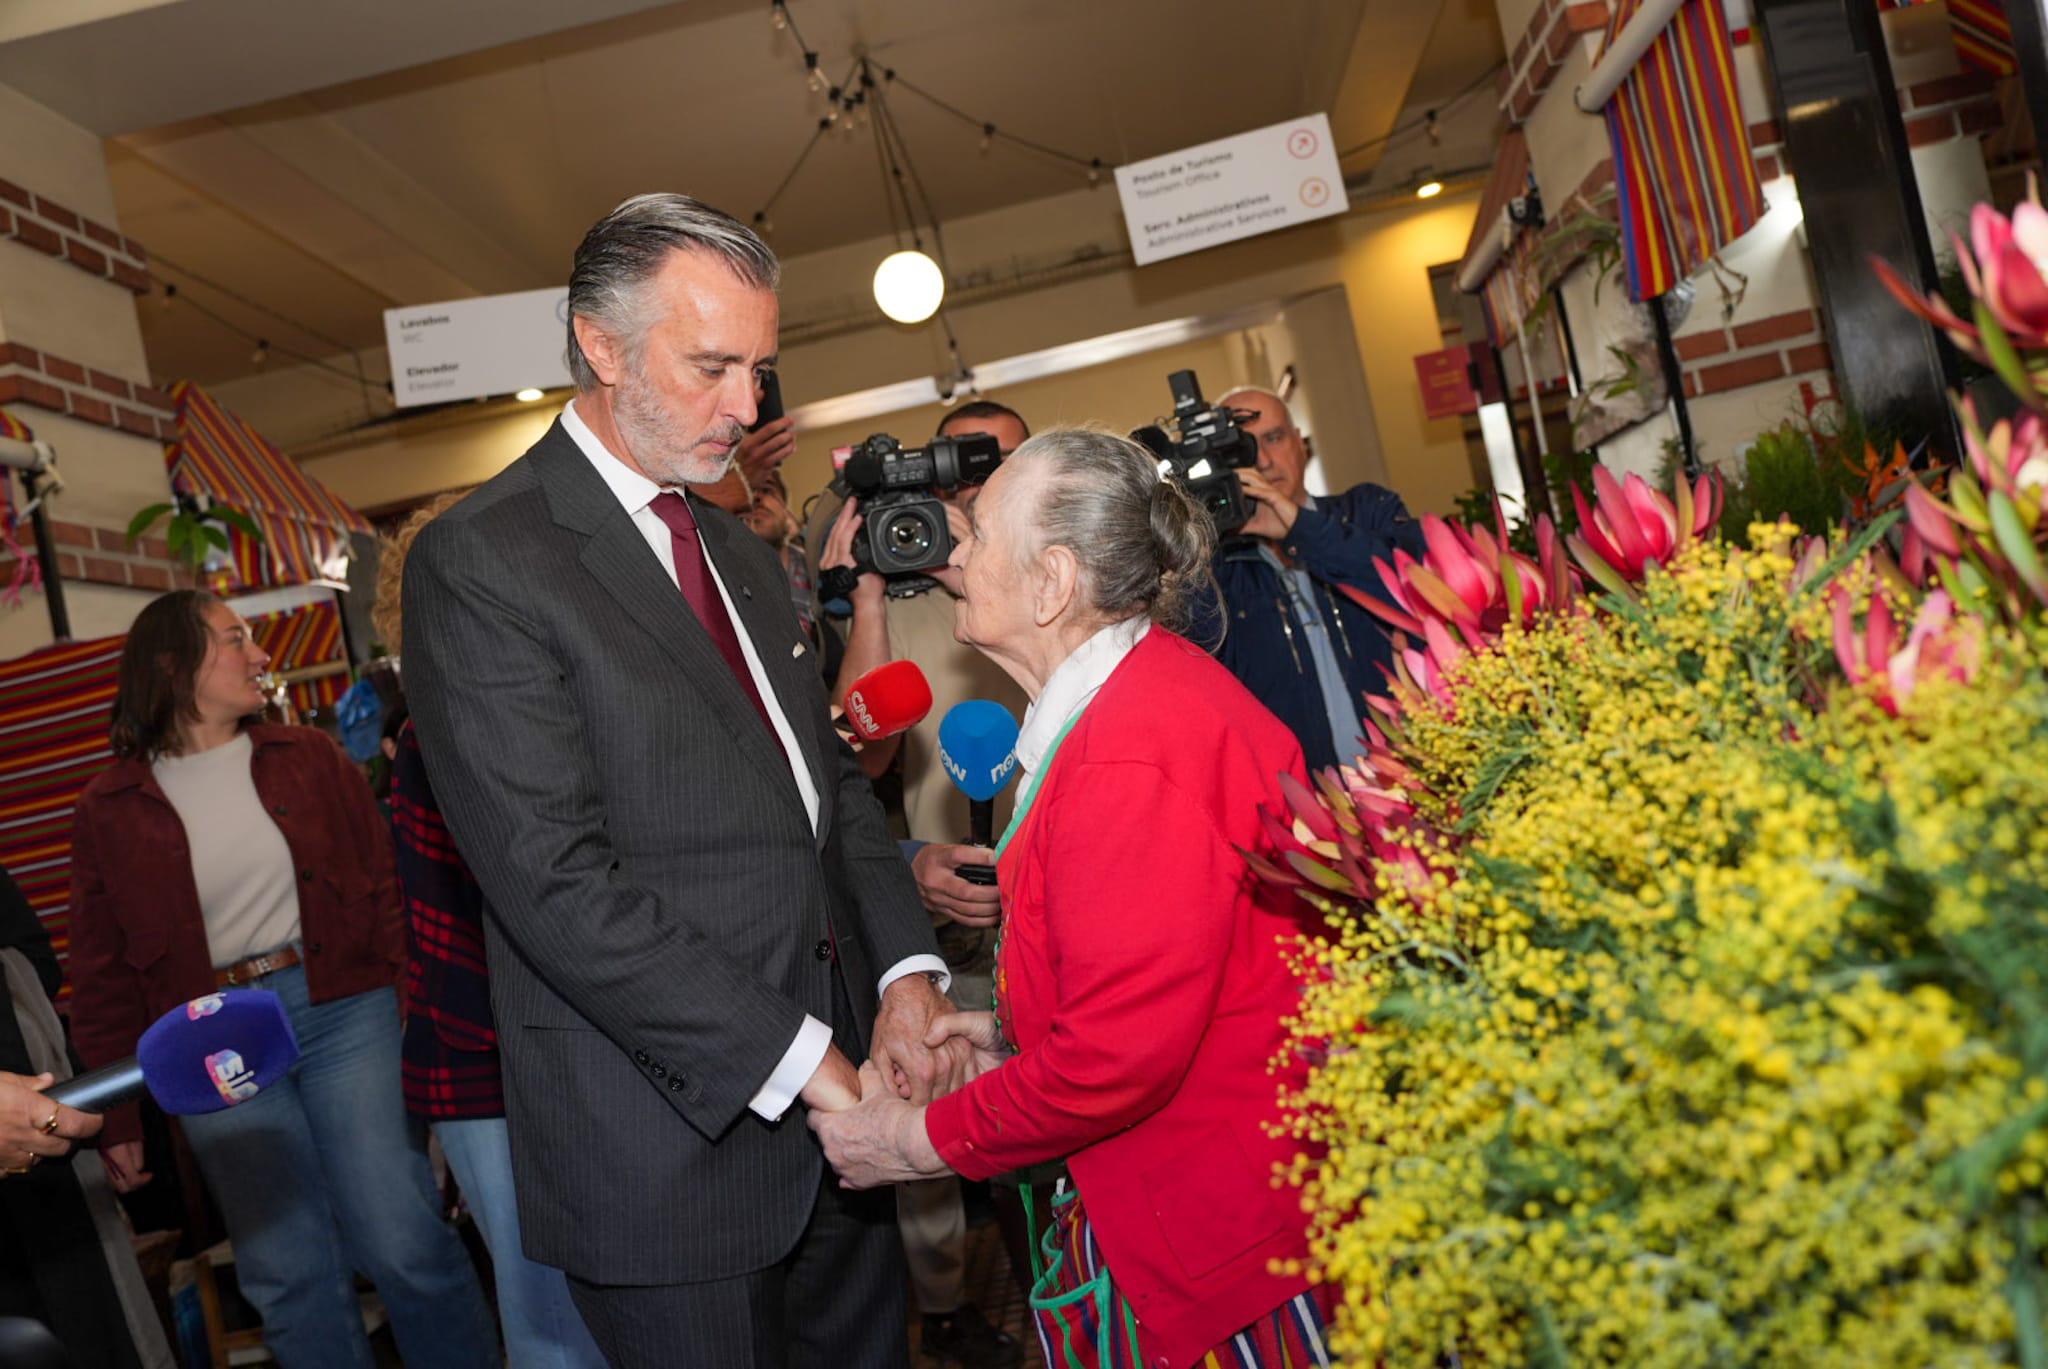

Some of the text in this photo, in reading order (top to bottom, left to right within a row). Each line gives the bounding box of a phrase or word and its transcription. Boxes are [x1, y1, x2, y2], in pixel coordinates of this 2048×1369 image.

[1132, 151, 1234, 186] Posto de Turismo
[1136, 169, 1221, 200] Tourism Office
[1147, 204, 1288, 249] Administrative Services
[400, 314, 450, 330] Lavabos
[406, 361, 460, 378] Elevador
[850, 690, 880, 734] CNN
